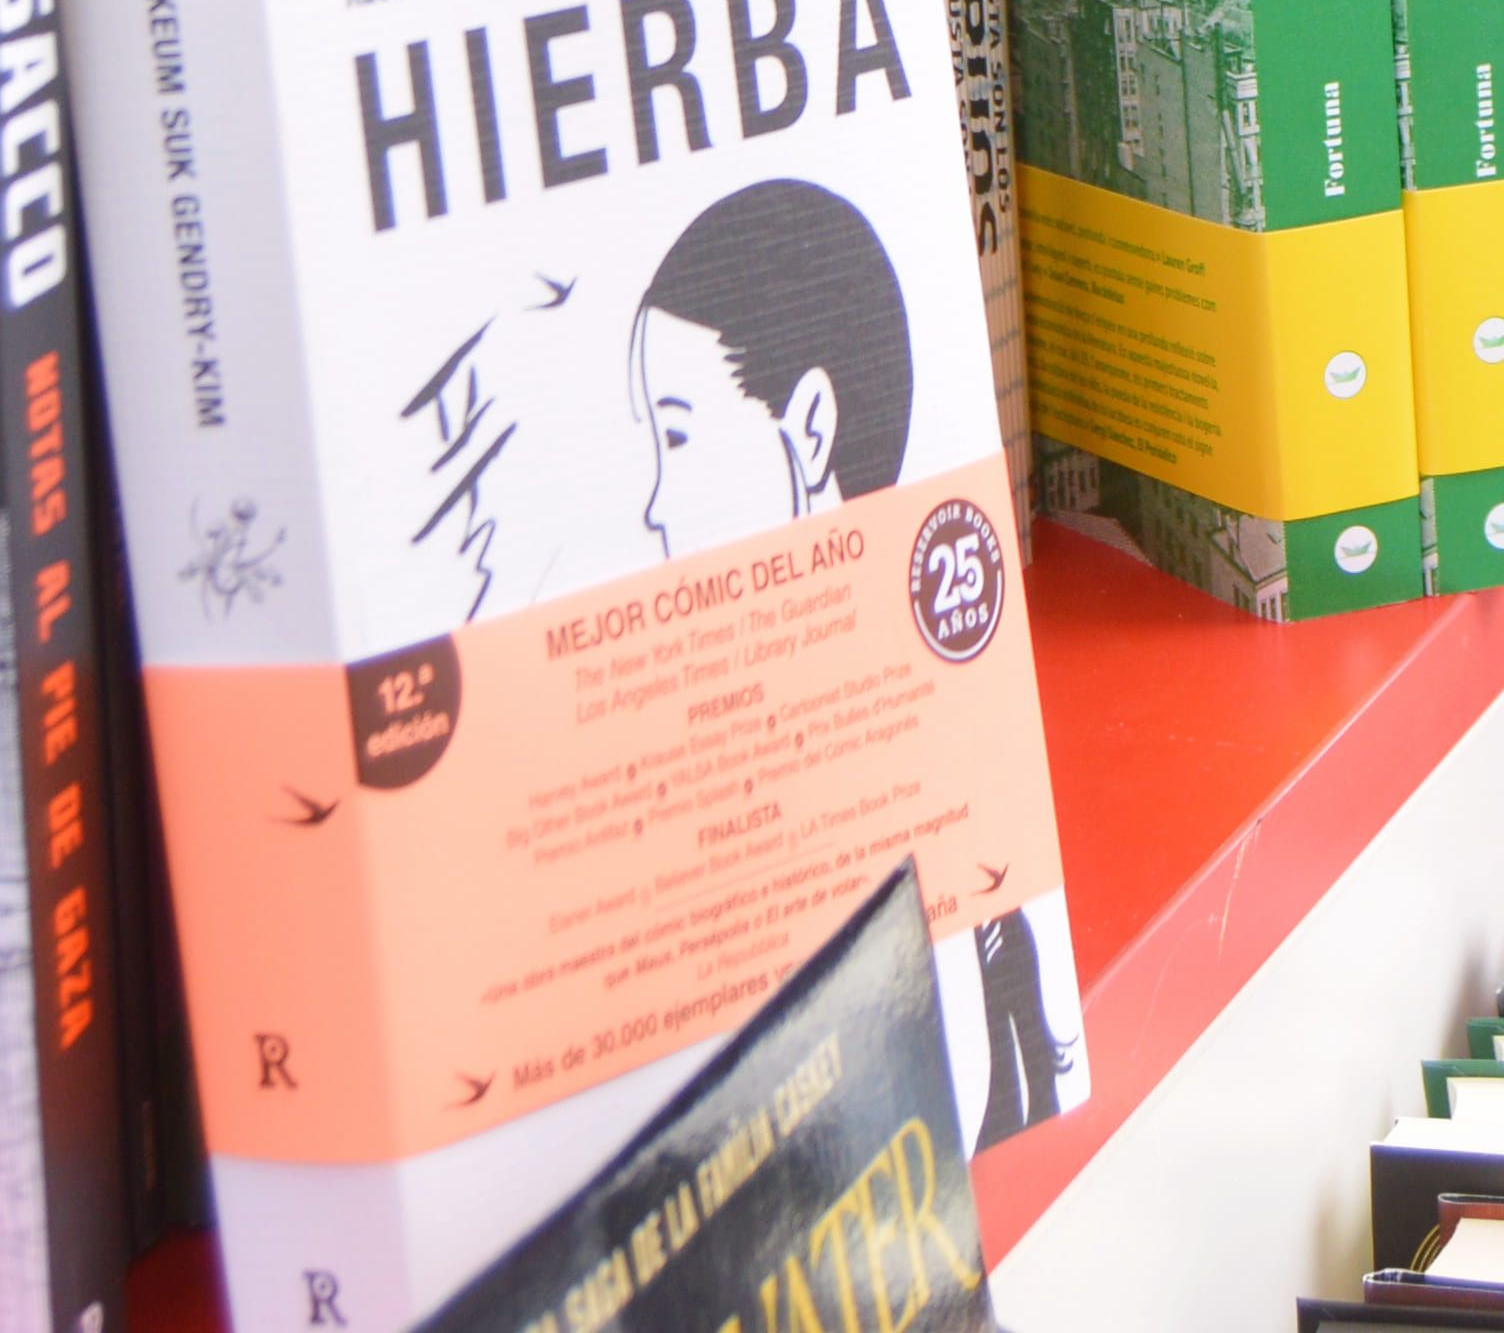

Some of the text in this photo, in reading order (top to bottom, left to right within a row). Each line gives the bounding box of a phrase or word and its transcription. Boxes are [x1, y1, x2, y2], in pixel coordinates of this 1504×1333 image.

[991, 61, 1007, 132] SON
[1476, 64, 1497, 177] Fortuna
[160, 106, 199, 184] SUK
[1324, 81, 1346, 197] Fortuna
[996, 147, 1010, 214] LOS
[172, 192, 226, 430] GENDRY-KIM
[928, 533, 985, 614] 25
[965, 506, 1000, 564] BOOKS
[546, 528, 865, 662] MEJOR CÓMIC DEL AÑO
[938, 603, 989, 641] AÑOS
[574, 583, 852, 692] The New York Times The Guardian
[26, 351, 93, 1051] NOTAS AL PIE DE GAZA
[366, 710, 450, 757] edición
[687, 683, 765, 725] PREMIOS
[698, 802, 782, 849] FINALISTA
[255, 1034, 298, 1091] R
[513, 973, 769, 1090] Más de 30.000 ejemplares
[564, 1247, 636, 1331] SAGA
[631, 1211, 667, 1288] DE
[665, 1181, 701, 1253] LA
